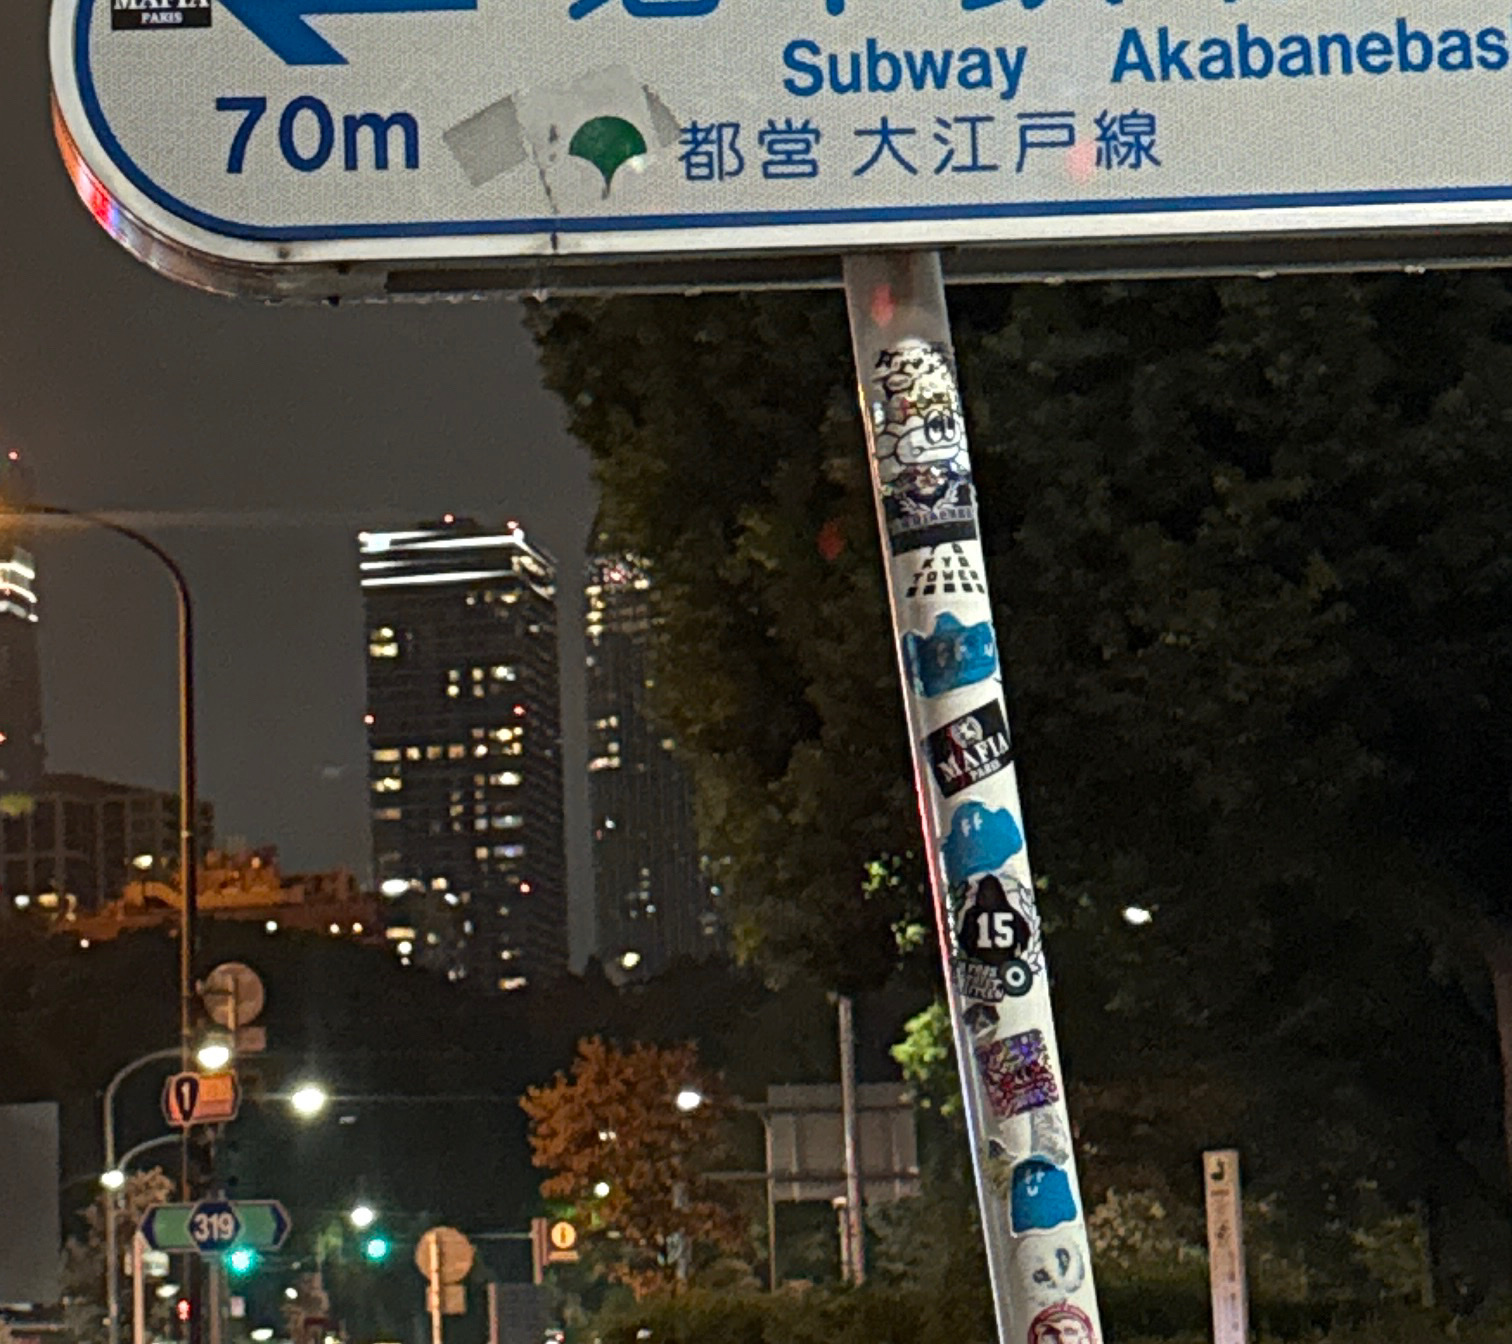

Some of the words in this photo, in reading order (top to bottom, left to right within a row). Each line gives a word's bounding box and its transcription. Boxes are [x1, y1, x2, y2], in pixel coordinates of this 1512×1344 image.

[141, 11, 183, 24] PARIS
[783, 39, 1027, 99] Subway
[1110, 17, 1510, 83] Akabanebas
[214, 95, 420, 174] 70m
[936, 732, 1009, 783] MAFIA
[976, 911, 1014, 949] 15
[194, 1212, 234, 1242] 319
